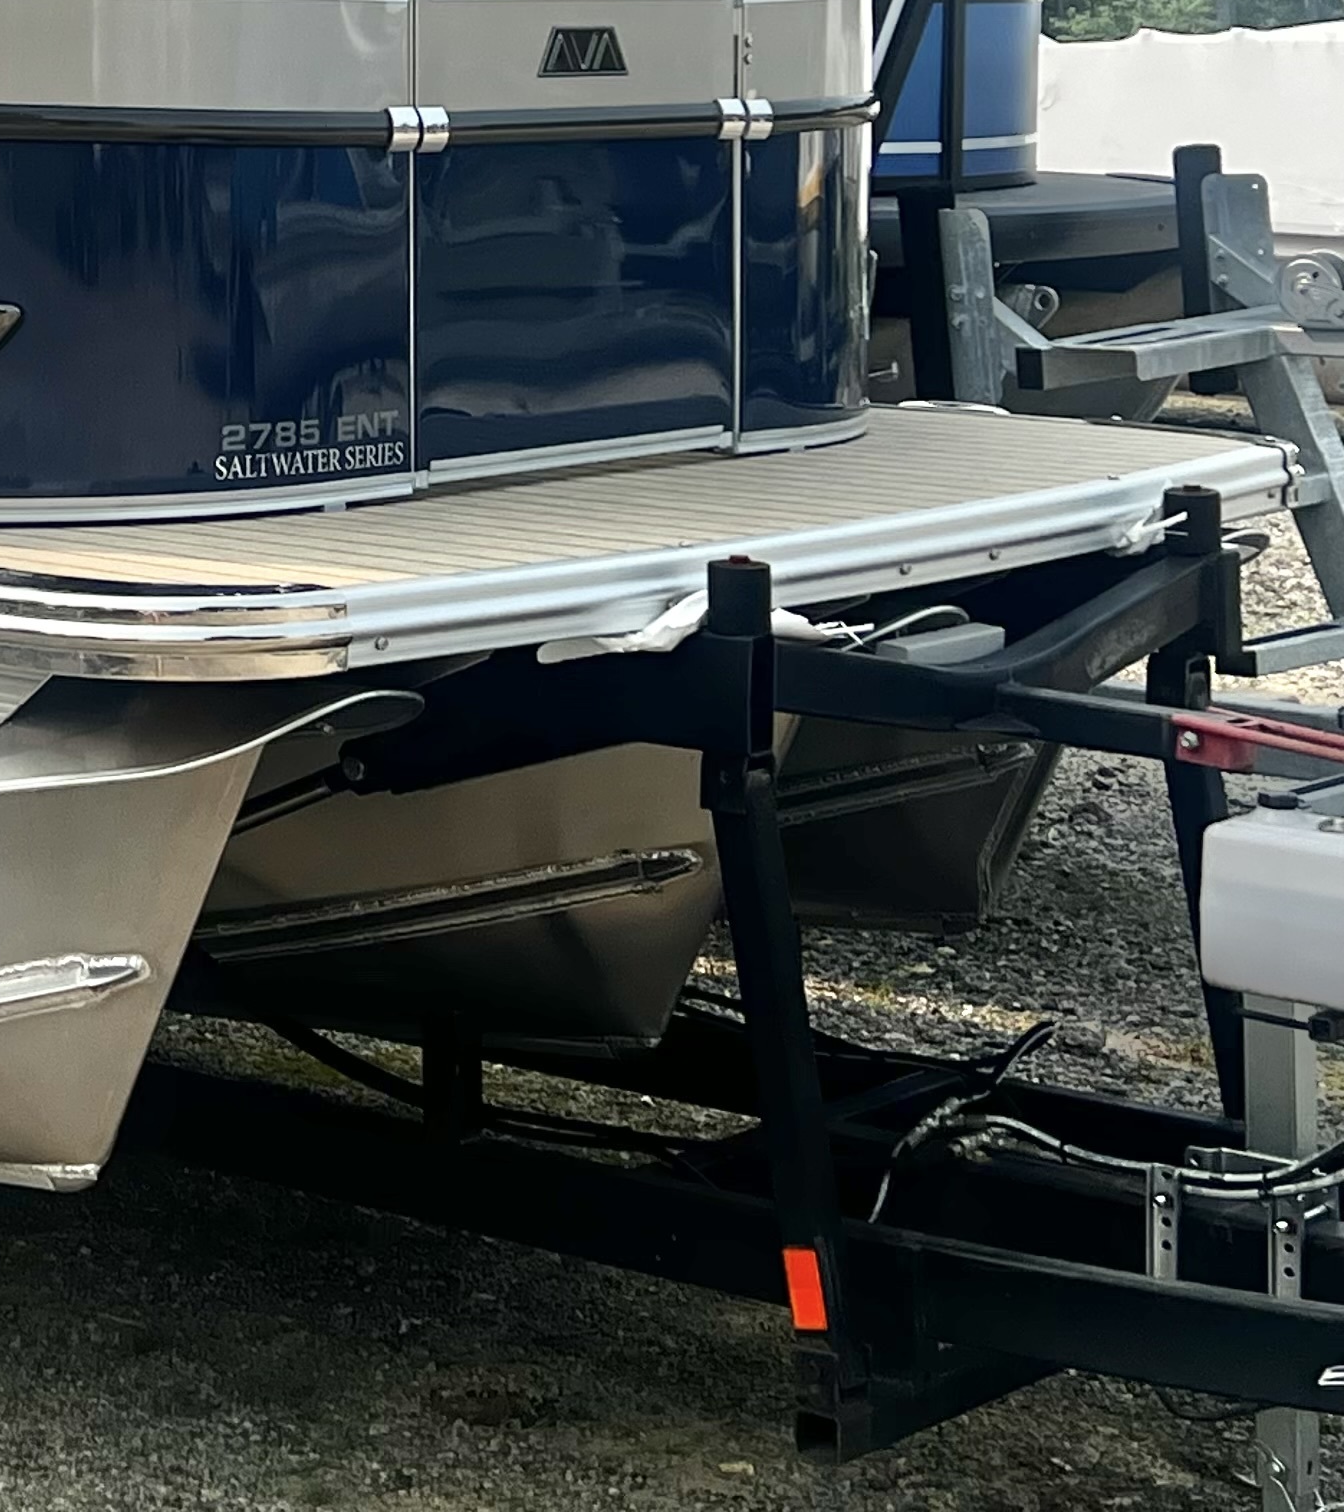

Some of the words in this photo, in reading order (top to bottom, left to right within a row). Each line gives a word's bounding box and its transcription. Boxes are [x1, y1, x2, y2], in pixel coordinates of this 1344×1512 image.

[545, 31, 621, 70] AVA
[221, 420, 320, 451] 2785
[337, 411, 399, 442] ENT
[344, 441, 404, 471] SERIES
